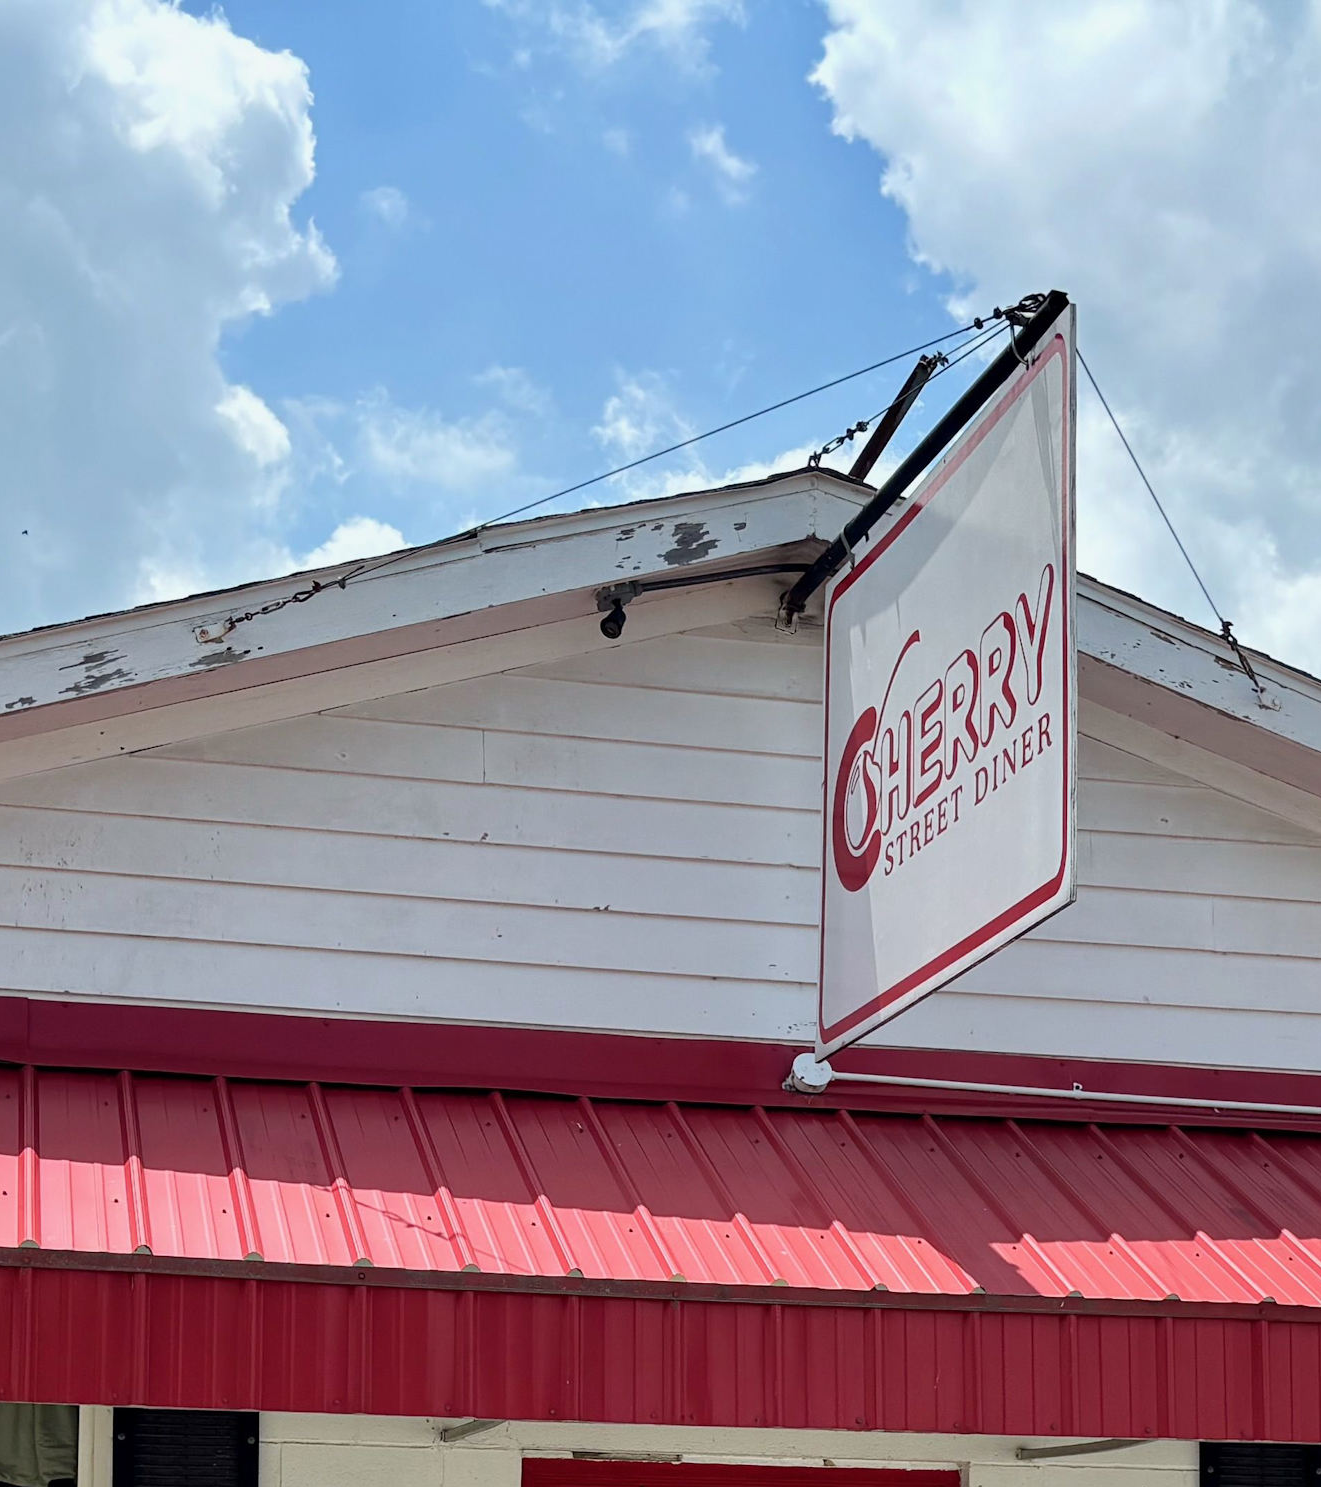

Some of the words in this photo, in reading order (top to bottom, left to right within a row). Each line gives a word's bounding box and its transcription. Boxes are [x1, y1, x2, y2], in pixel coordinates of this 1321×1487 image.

[832, 563, 1054, 891] CHERRY
[884, 786, 964, 876] STREET
[974, 713, 1052, 806] DINER
